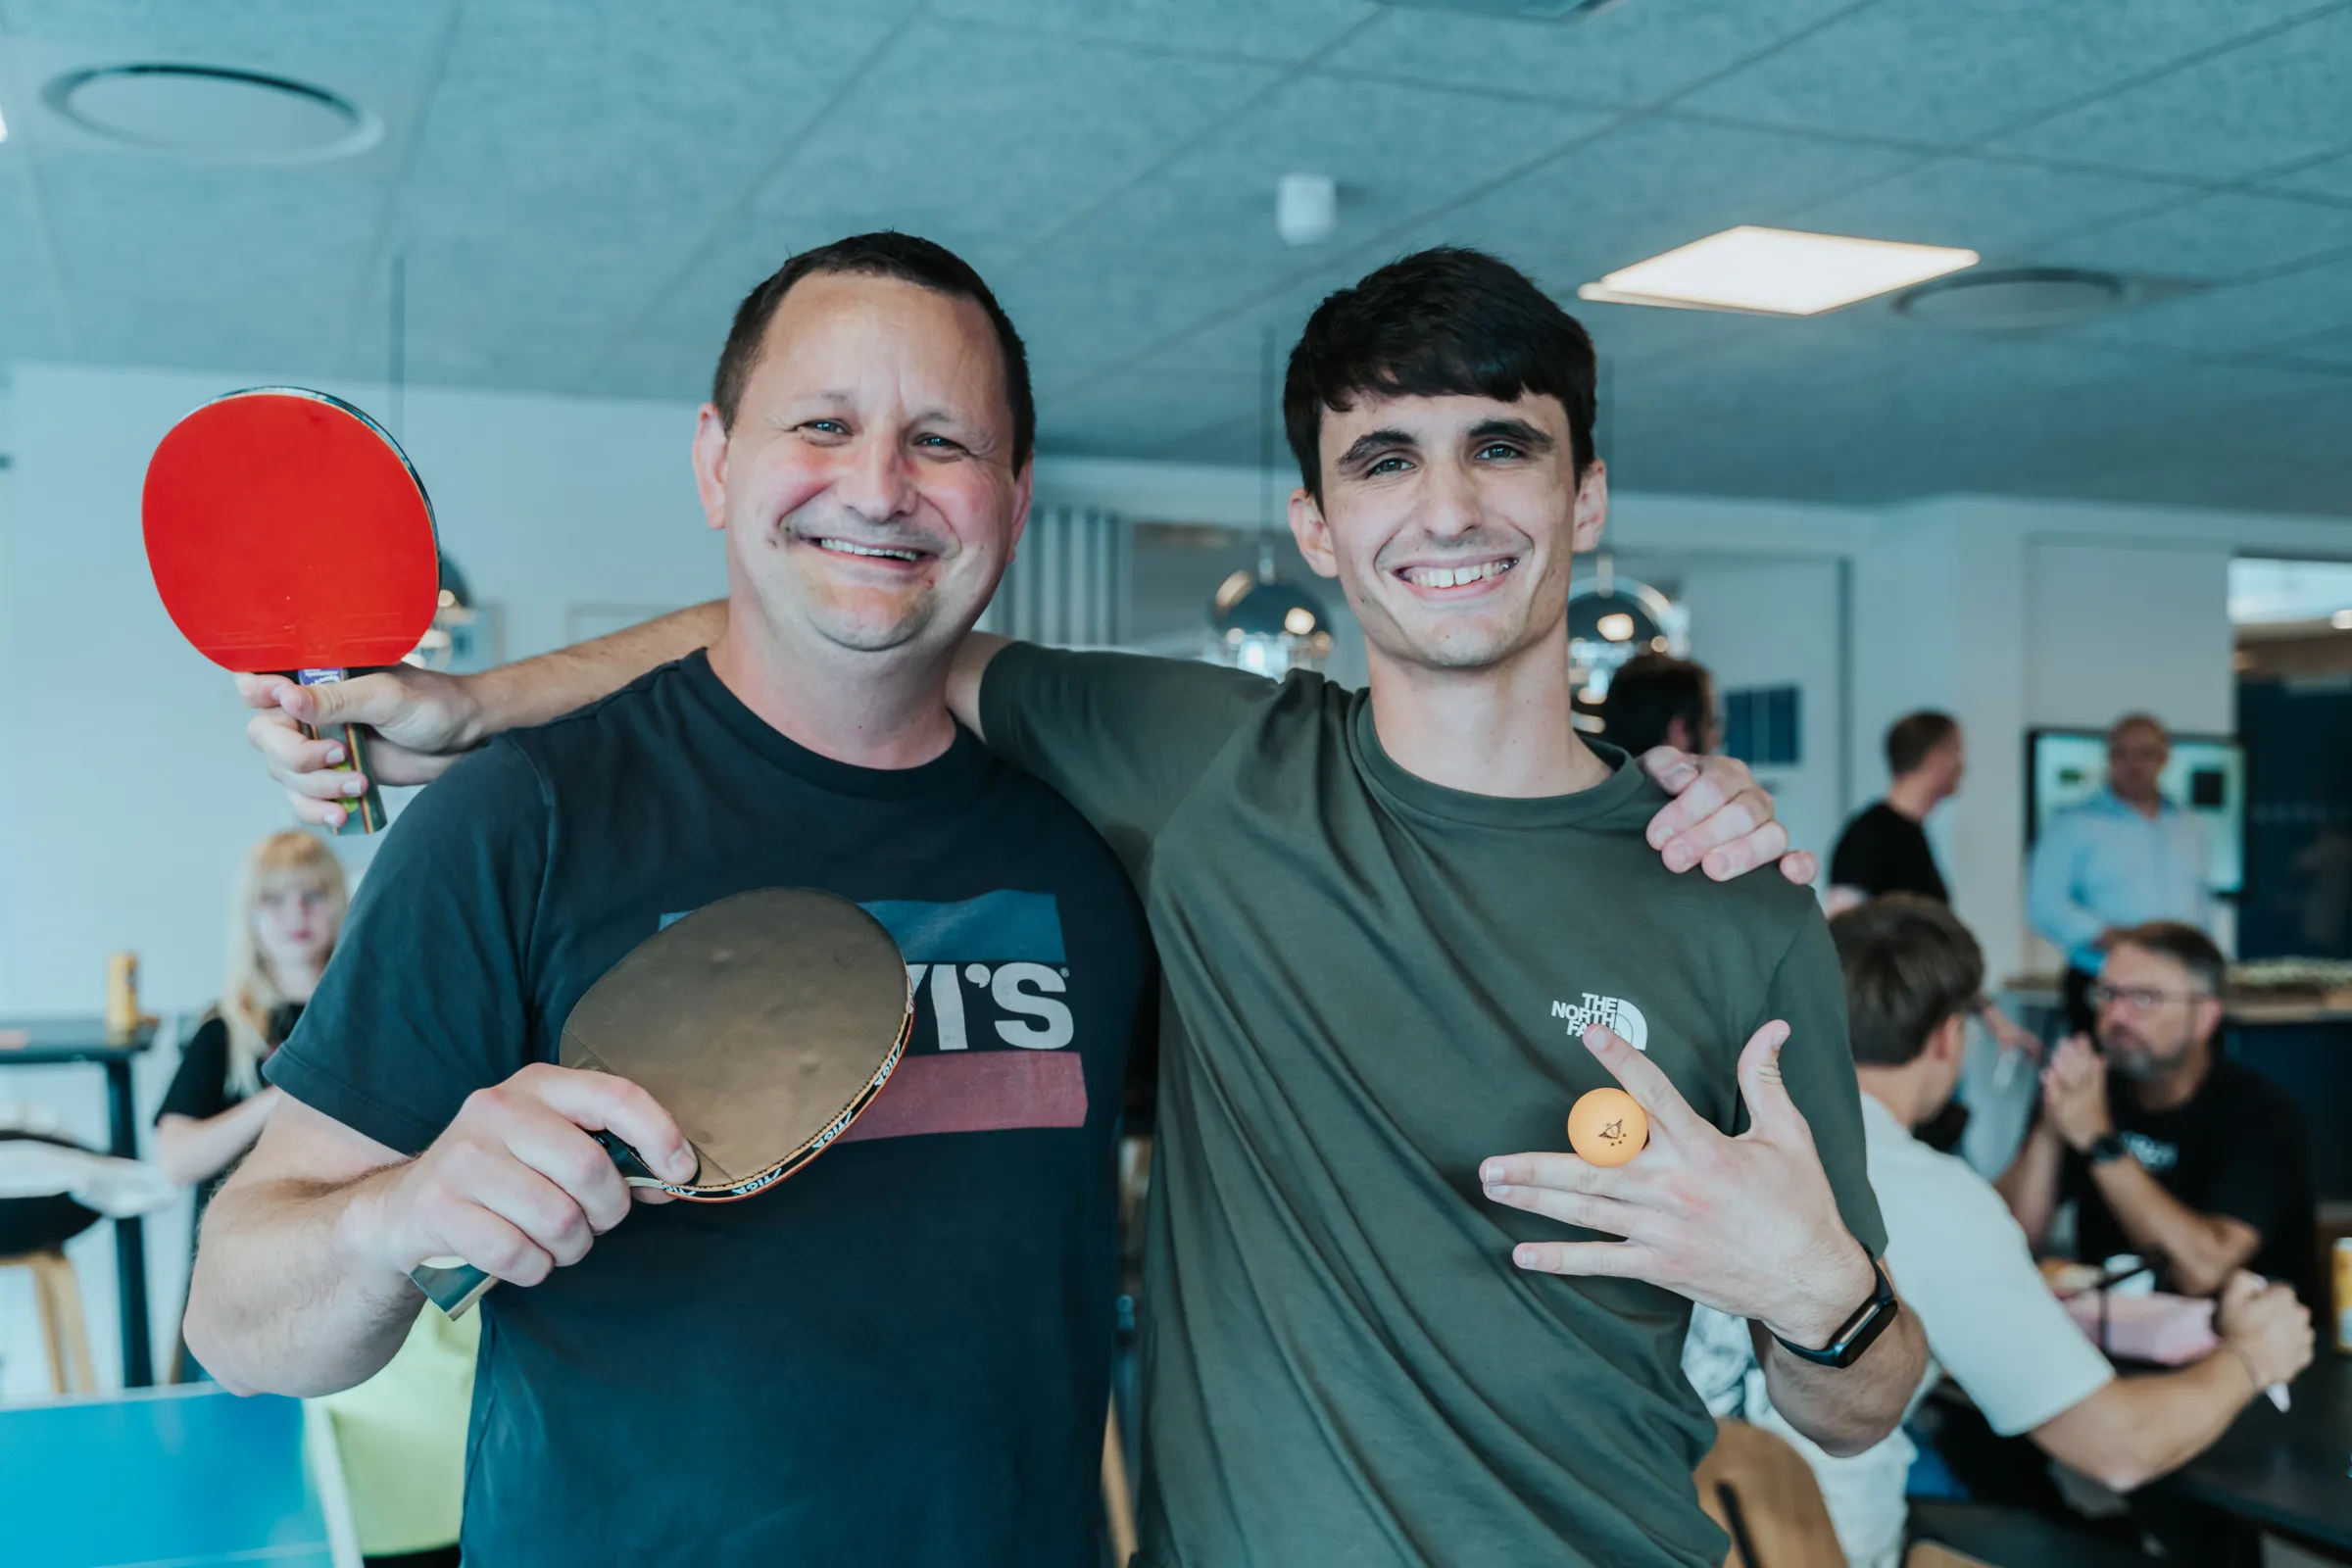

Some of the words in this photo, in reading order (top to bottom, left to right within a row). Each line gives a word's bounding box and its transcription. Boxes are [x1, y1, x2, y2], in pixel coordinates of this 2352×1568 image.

[1550, 1001, 1615, 1029] NORTH
[1582, 992, 1618, 1013] THE
[874, 1043, 901, 1086] STIGA
[812, 1110, 853, 1149] STIGA
[732, 1167, 782, 1196] STIGA
